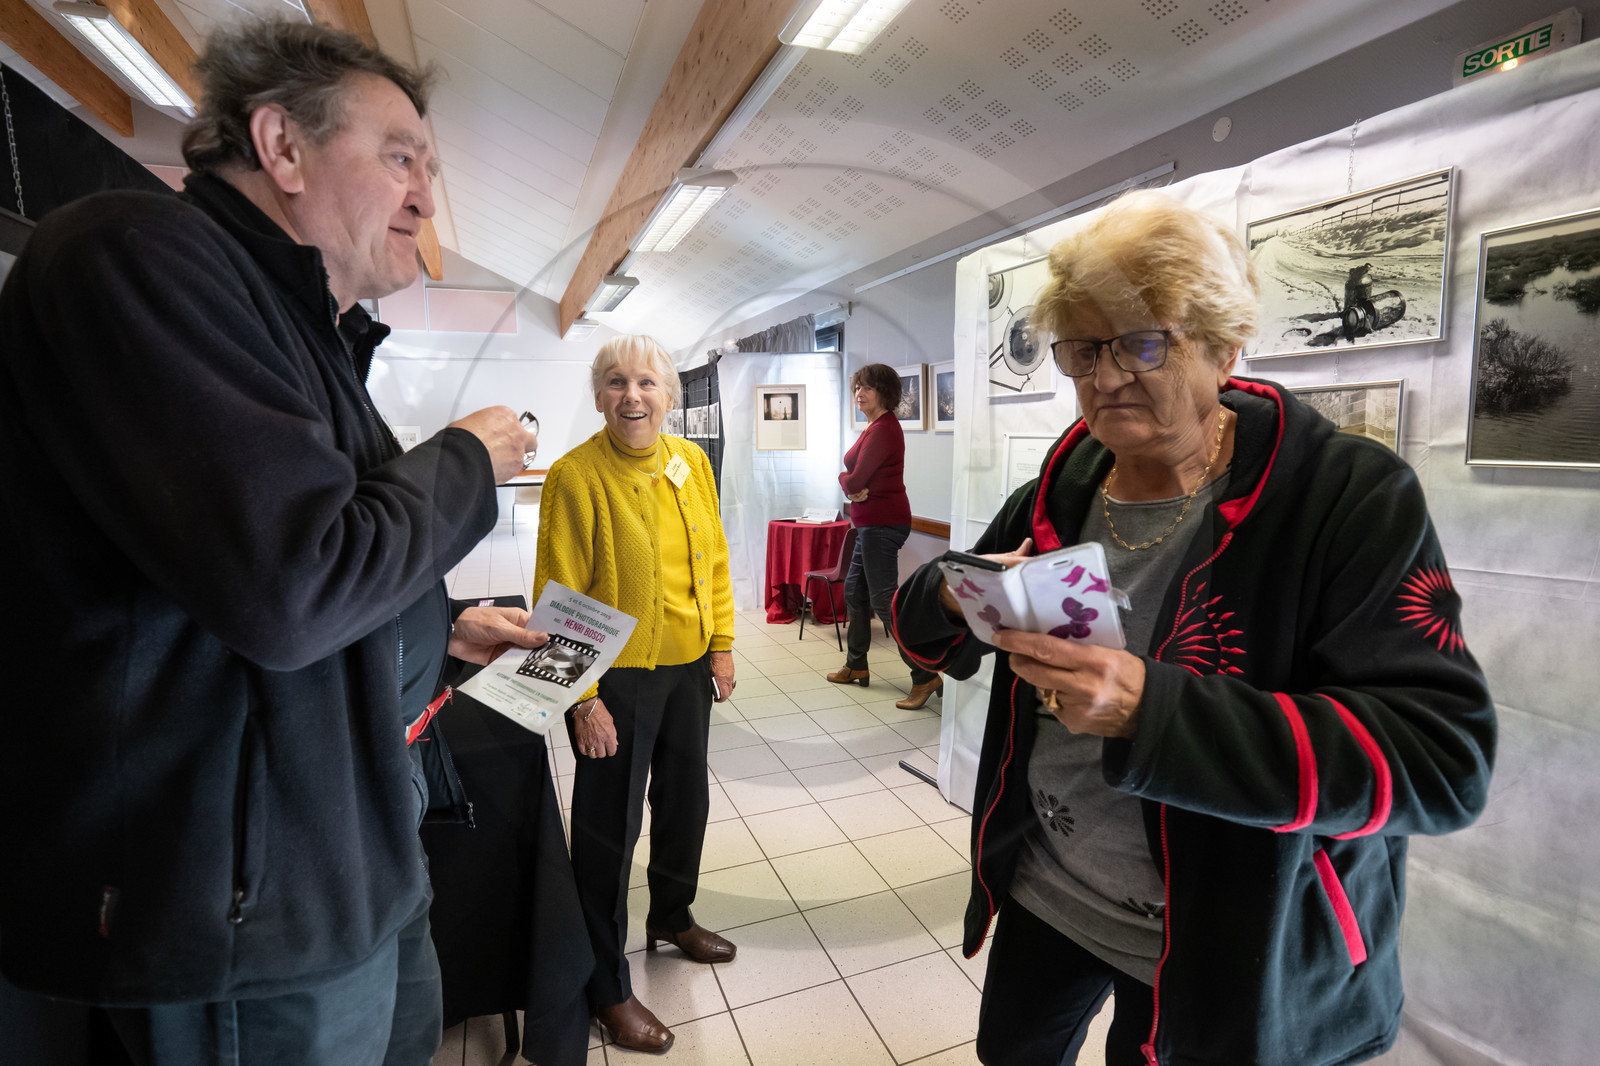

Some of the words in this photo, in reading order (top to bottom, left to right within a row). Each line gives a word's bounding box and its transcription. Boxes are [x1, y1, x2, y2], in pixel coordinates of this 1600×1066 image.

[1464, 27, 1551, 74] SORTIE
[549, 600, 577, 616] DIALOGUE
[575, 611, 620, 637] PHOTOGRAPHIQUE
[582, 603, 600, 614] octobre
[564, 618, 585, 634] HENRI
[583, 627, 606, 644] BOSCO
